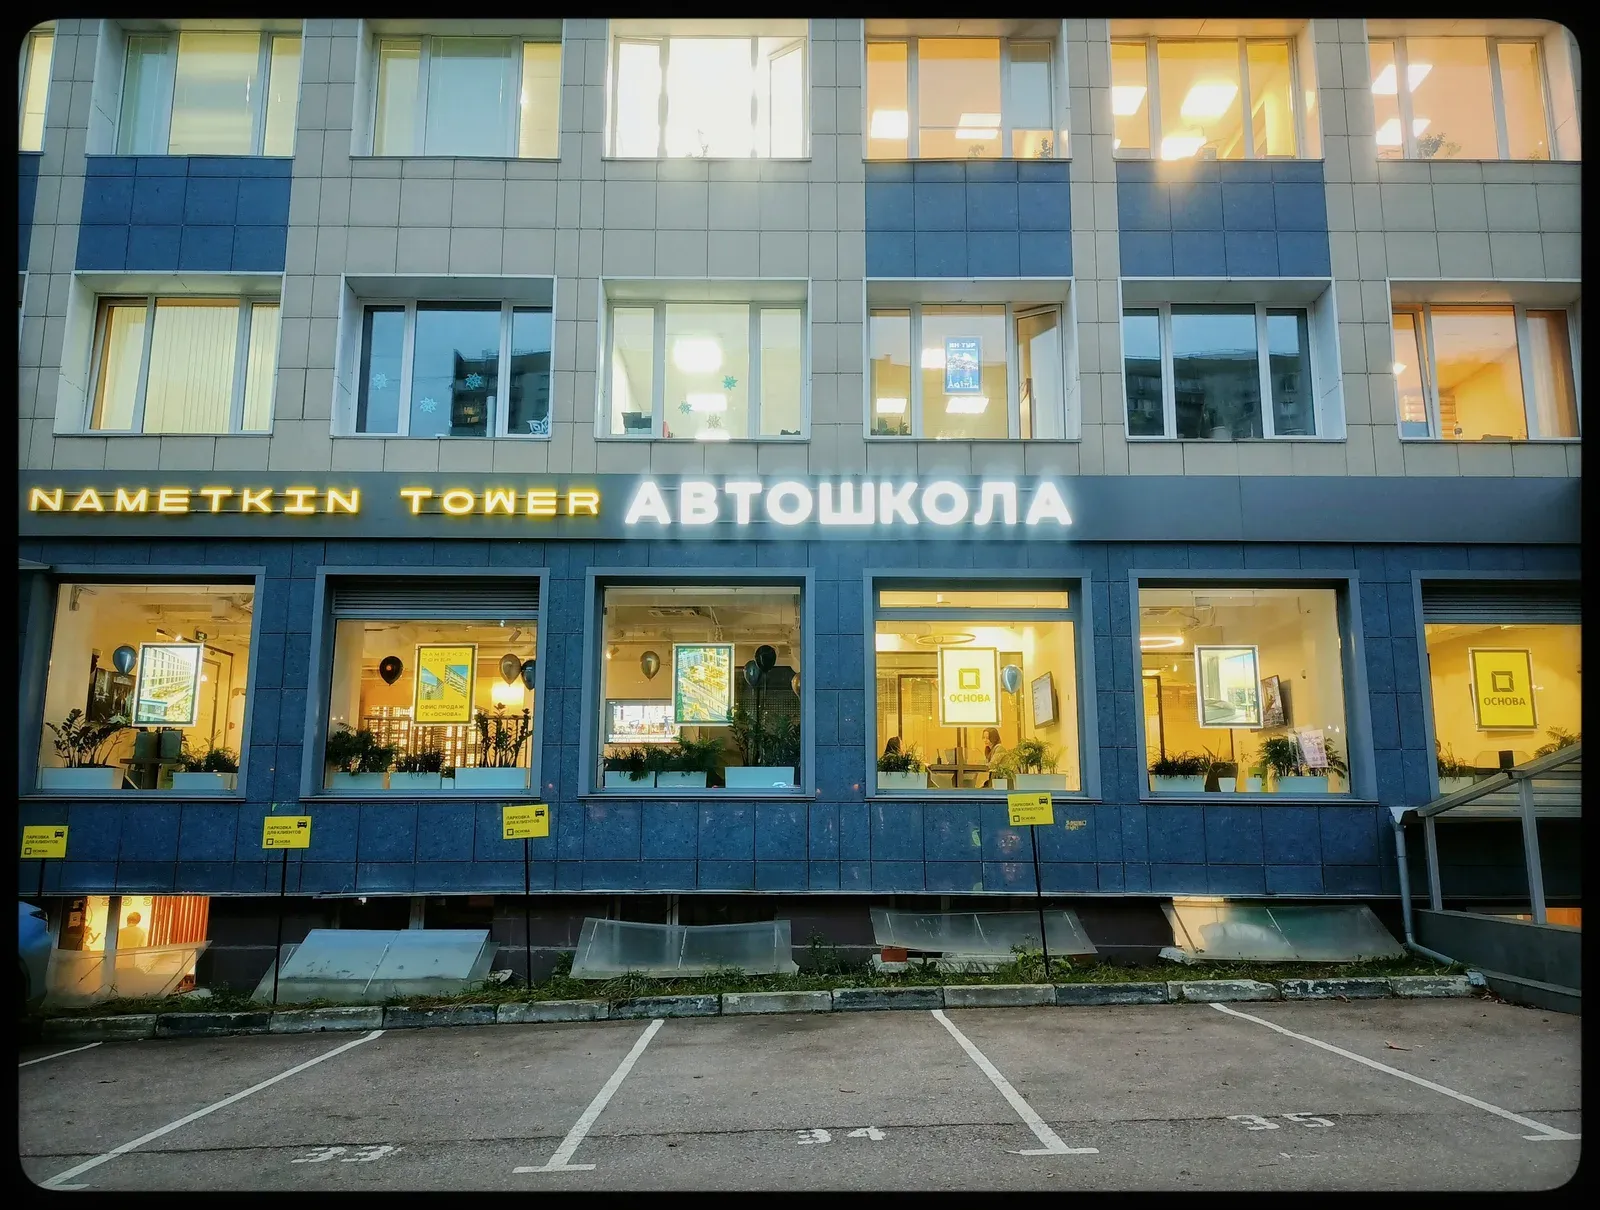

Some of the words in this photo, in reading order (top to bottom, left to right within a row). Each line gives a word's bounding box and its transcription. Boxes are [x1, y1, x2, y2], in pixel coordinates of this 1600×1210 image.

[28, 487, 361, 514] NAMETKIN
[399, 487, 601, 516] TOWER
[623, 480, 1074, 527] АВТОШКОЛА
[949, 693, 991, 703] ОСНОВА
[1483, 697, 1526, 706] ОСНОВА
[1226, 1111, 1336, 1130] 35
[795, 1126, 886, 1145] 34
[291, 1145, 394, 1163] 33
